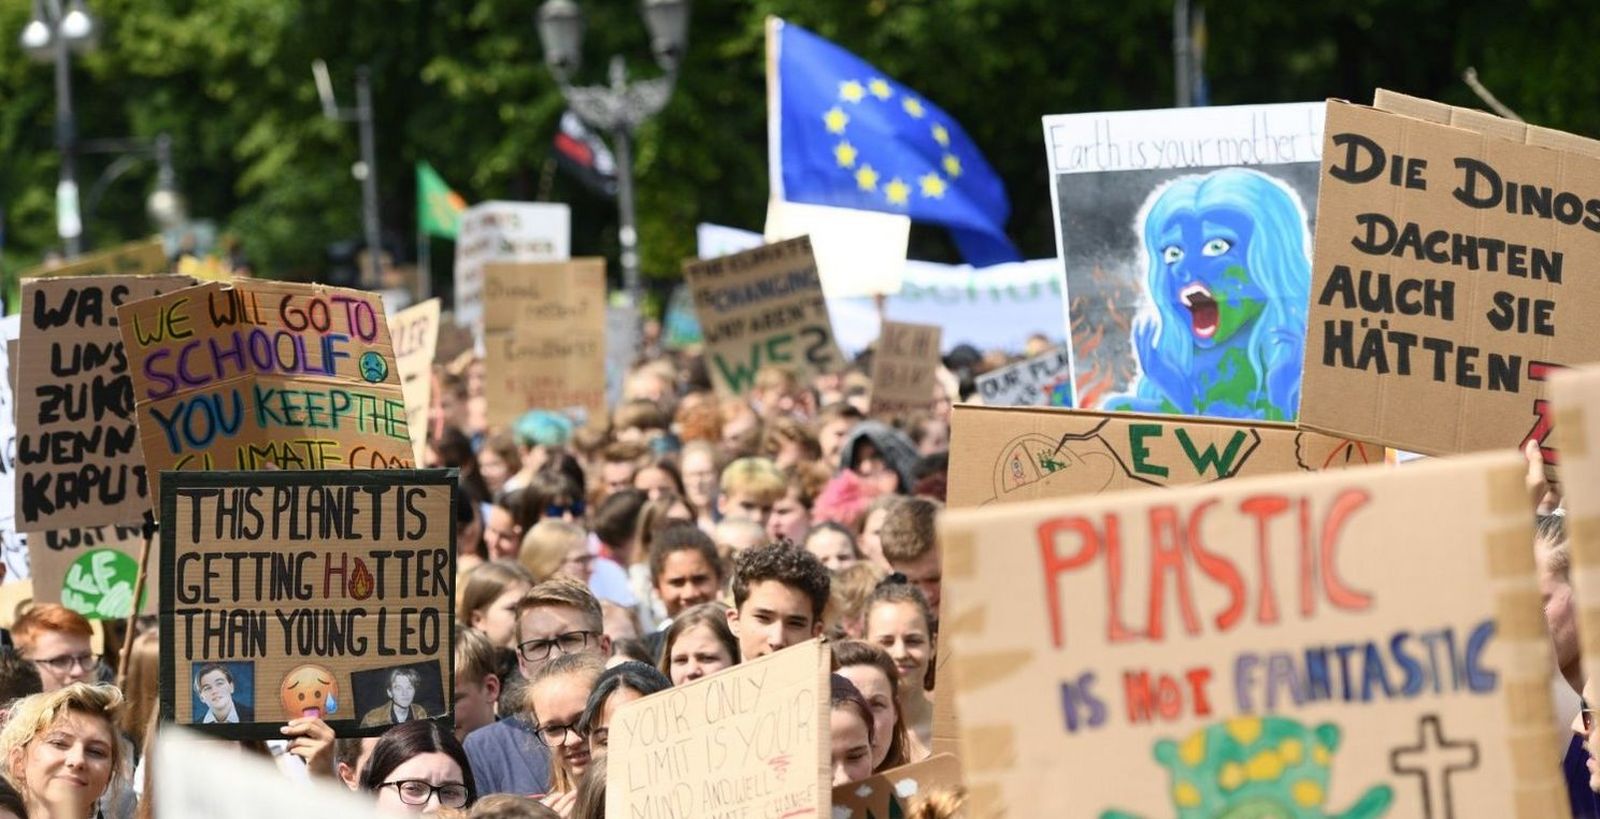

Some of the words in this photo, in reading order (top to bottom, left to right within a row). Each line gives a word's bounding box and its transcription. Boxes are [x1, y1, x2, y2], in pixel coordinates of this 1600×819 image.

[1050, 119, 1121, 170] Earth
[1129, 140, 1147, 168] is
[1151, 137, 1211, 169] your
[1217, 111, 1301, 165] mother
[1329, 133, 1427, 190] DIE
[1351, 213, 1563, 284] DACHTEN
[132, 298, 193, 347] WE
[208, 290, 267, 328] WILL
[280, 294, 331, 333] GO
[331, 296, 377, 343] TO
[1318, 265, 1455, 321] AUCH
[1486, 291, 1555, 336] SIE
[51, 342, 127, 377] UNS
[144, 329, 325, 399] SCHOOL
[321, 334, 350, 377] IF
[1323, 317, 1521, 393] HÄTTEN
[19, 425, 136, 465] WENN
[149, 389, 245, 453] YOU
[253, 383, 350, 429] KEEP
[349, 393, 411, 440] THE
[177, 486, 264, 544] THIS
[272, 485, 391, 540] PLANET
[398, 486, 427, 540] IS
[177, 552, 317, 604] GETTING
[1036, 487, 1376, 648] PLASTIC
[176, 608, 266, 661] THAN
[275, 608, 367, 657] YOUNG
[377, 607, 440, 657] LEO
[622, 690, 690, 748] YOUR
[705, 667, 767, 724] ONLY
[1060, 671, 1108, 733] IS
[1123, 668, 1212, 723] NOT
[1233, 620, 1499, 713] FANTASTIC
[627, 738, 693, 792] LIMIT
[706, 726, 727, 772] IS
[736, 689, 812, 767] YOUR
[630, 782, 693, 819] MIND
